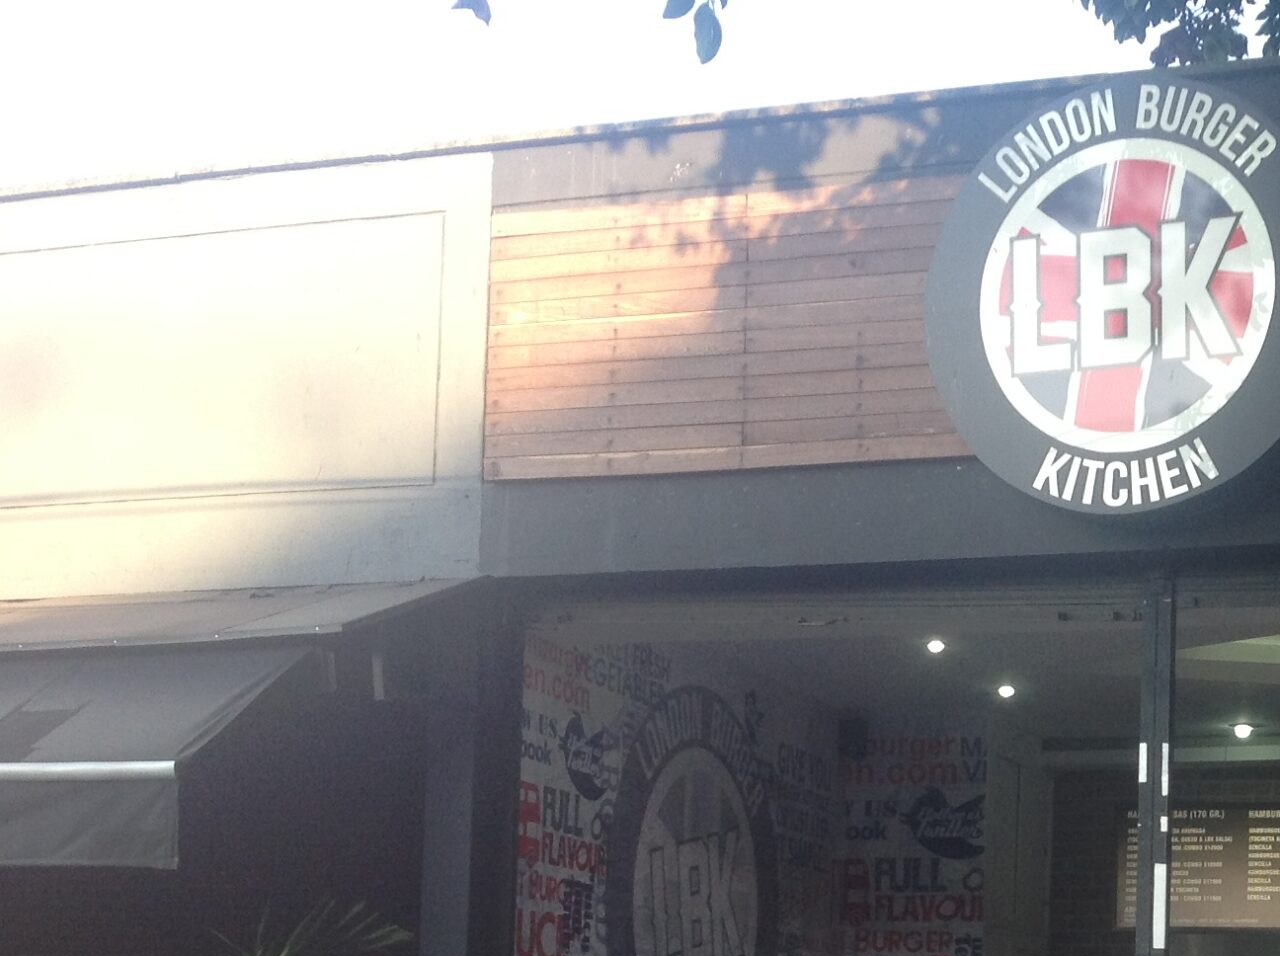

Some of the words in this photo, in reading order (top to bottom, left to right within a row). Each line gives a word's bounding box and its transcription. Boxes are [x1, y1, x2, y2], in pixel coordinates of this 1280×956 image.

[978, 89, 1117, 204] LONDON
[1136, 84, 1277, 178] BURGER
[1009, 211, 1243, 377] LBK
[1032, 438, 1219, 507] KITCHEN
[855, 930, 953, 953] BURGER
